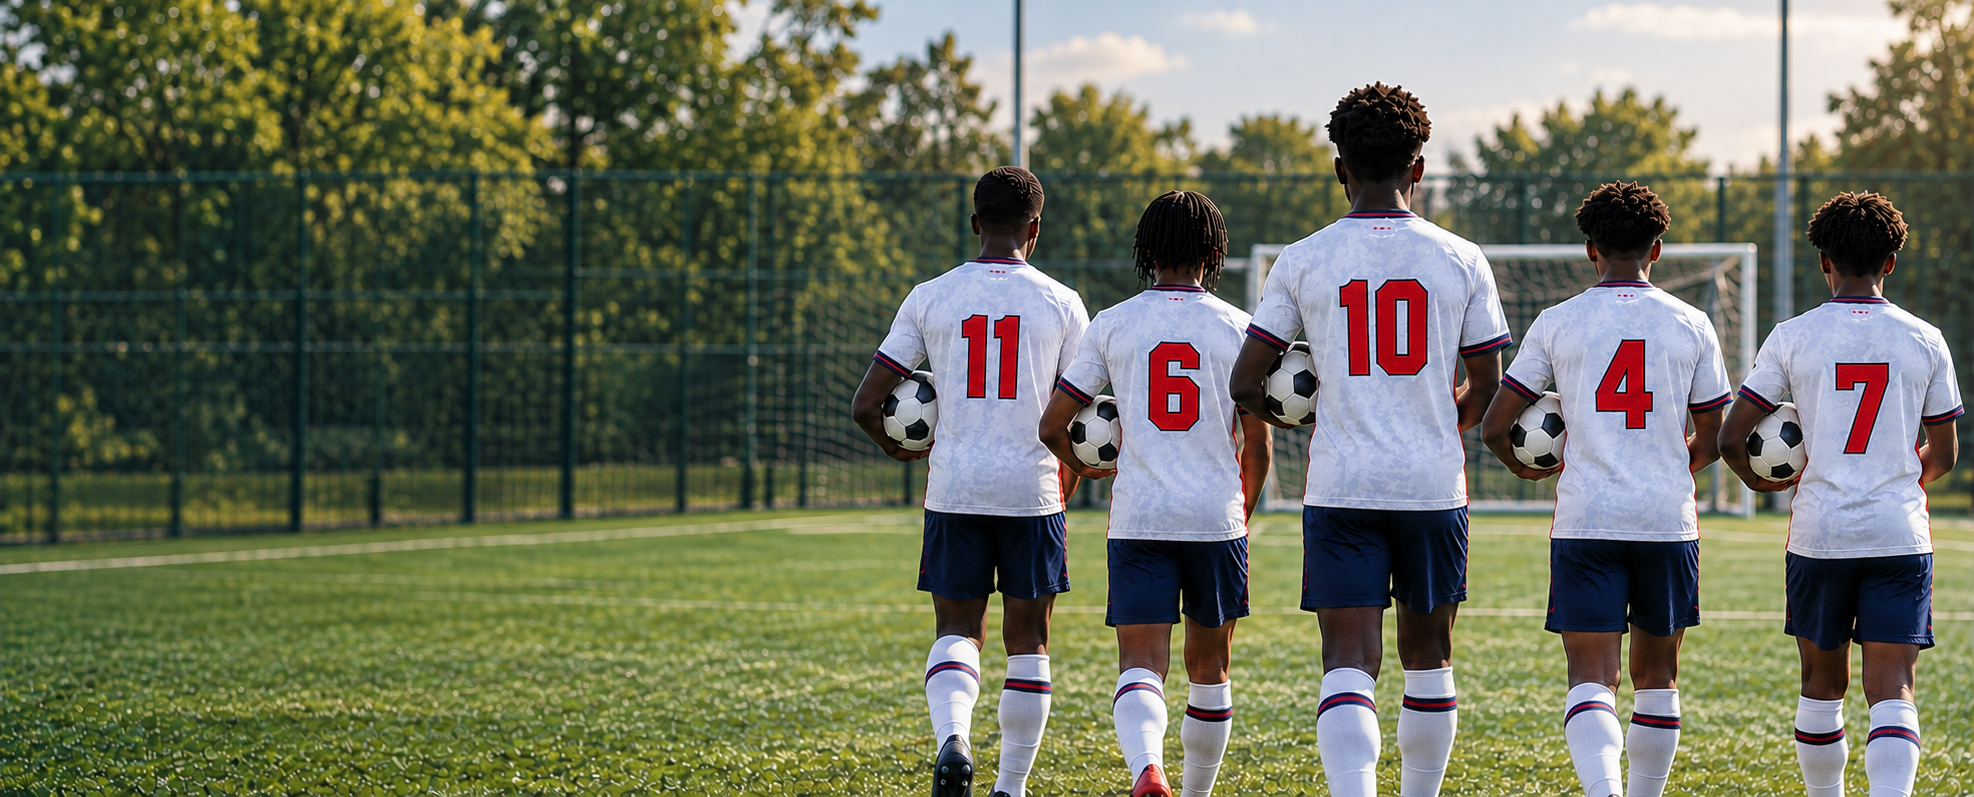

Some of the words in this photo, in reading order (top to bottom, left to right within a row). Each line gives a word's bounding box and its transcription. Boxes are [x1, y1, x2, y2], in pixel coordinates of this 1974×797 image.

[962, 315, 1020, 399] 11
[1339, 279, 1428, 376] 10
[1148, 341, 1200, 431] 6
[1596, 339, 1653, 429] 4
[1835, 362, 1889, 454] 7
